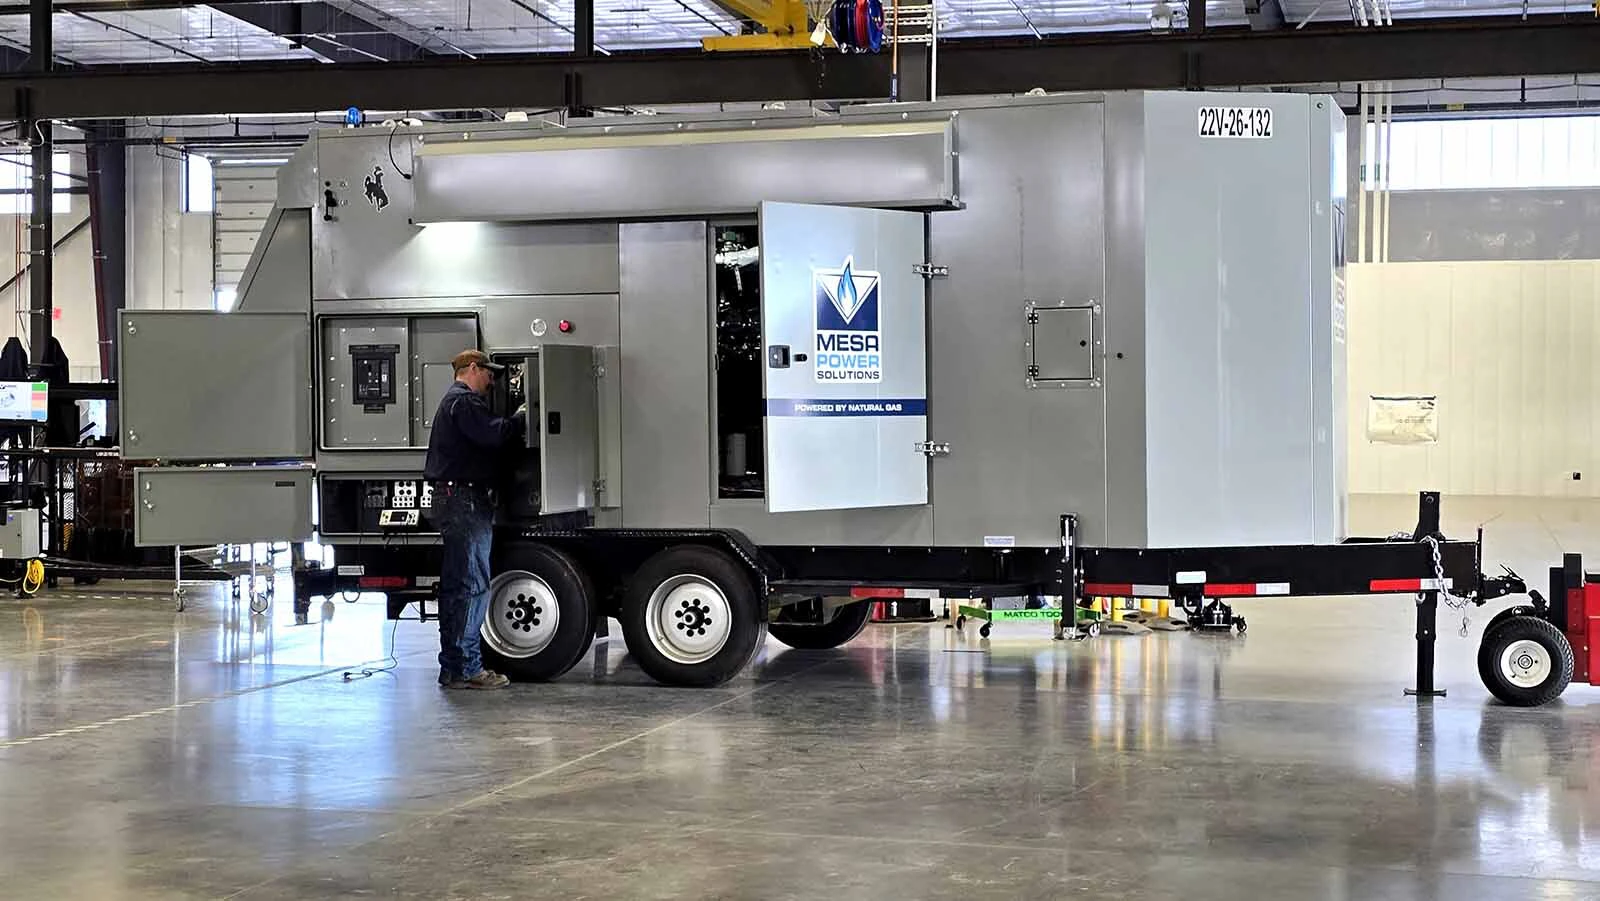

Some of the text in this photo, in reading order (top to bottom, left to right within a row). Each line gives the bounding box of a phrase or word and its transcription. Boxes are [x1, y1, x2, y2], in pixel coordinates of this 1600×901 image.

[1200, 108, 1271, 137] 22V-26-132
[816, 333, 879, 352] MESA
[816, 354, 880, 369] POWER
[816, 370, 880, 380] SOLUTIONS
[794, 403, 902, 412] POWERED BY NATURAL GAS
